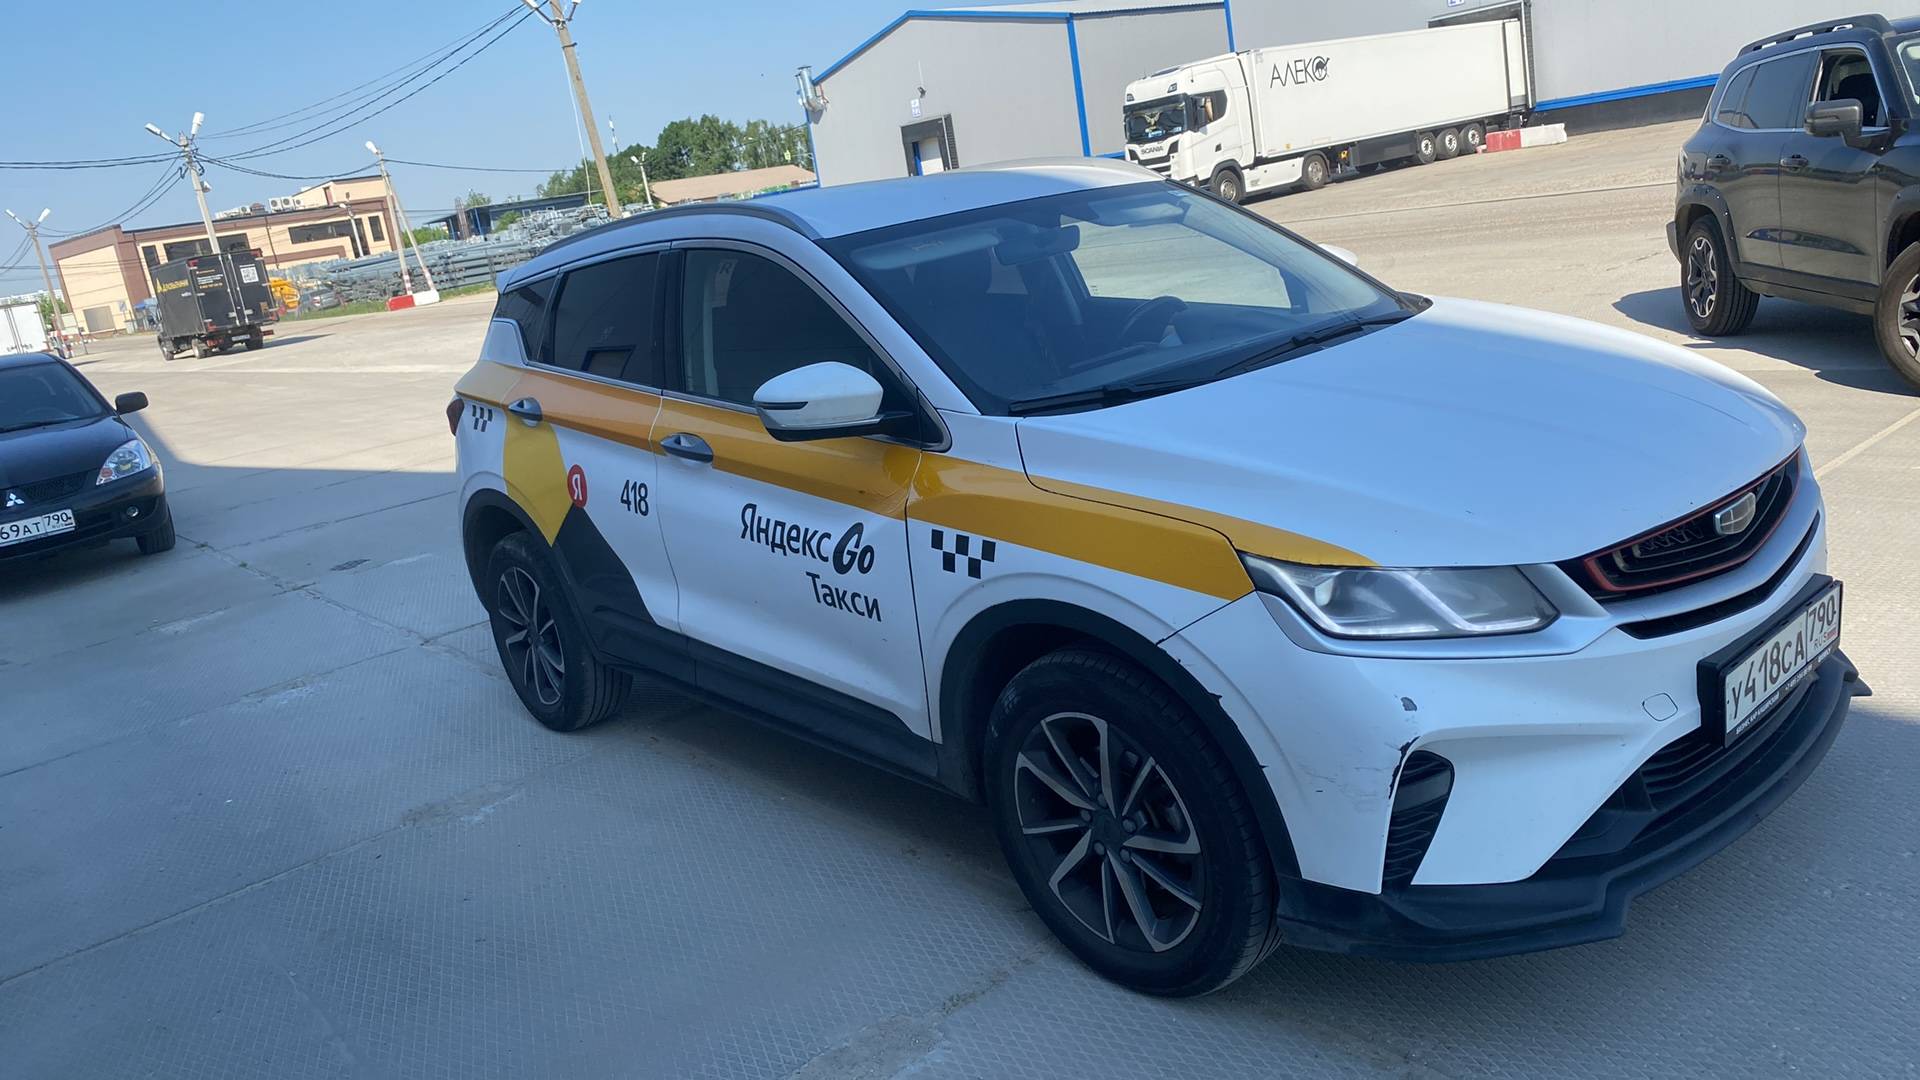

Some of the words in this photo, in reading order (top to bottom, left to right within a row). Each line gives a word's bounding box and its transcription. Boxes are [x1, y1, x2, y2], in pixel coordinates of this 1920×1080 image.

[1141, 146, 1164, 155] SCANIA
[572, 473, 583, 501] Я
[620, 479, 649, 516] 418
[44, 511, 68, 527] 790
[741, 503, 832, 563] Яндекс
[832, 522, 875, 575] Go
[805, 570, 882, 622] Такси
[1732, 630, 1805, 721] У418СА
[1808, 594, 1834, 642] 790
